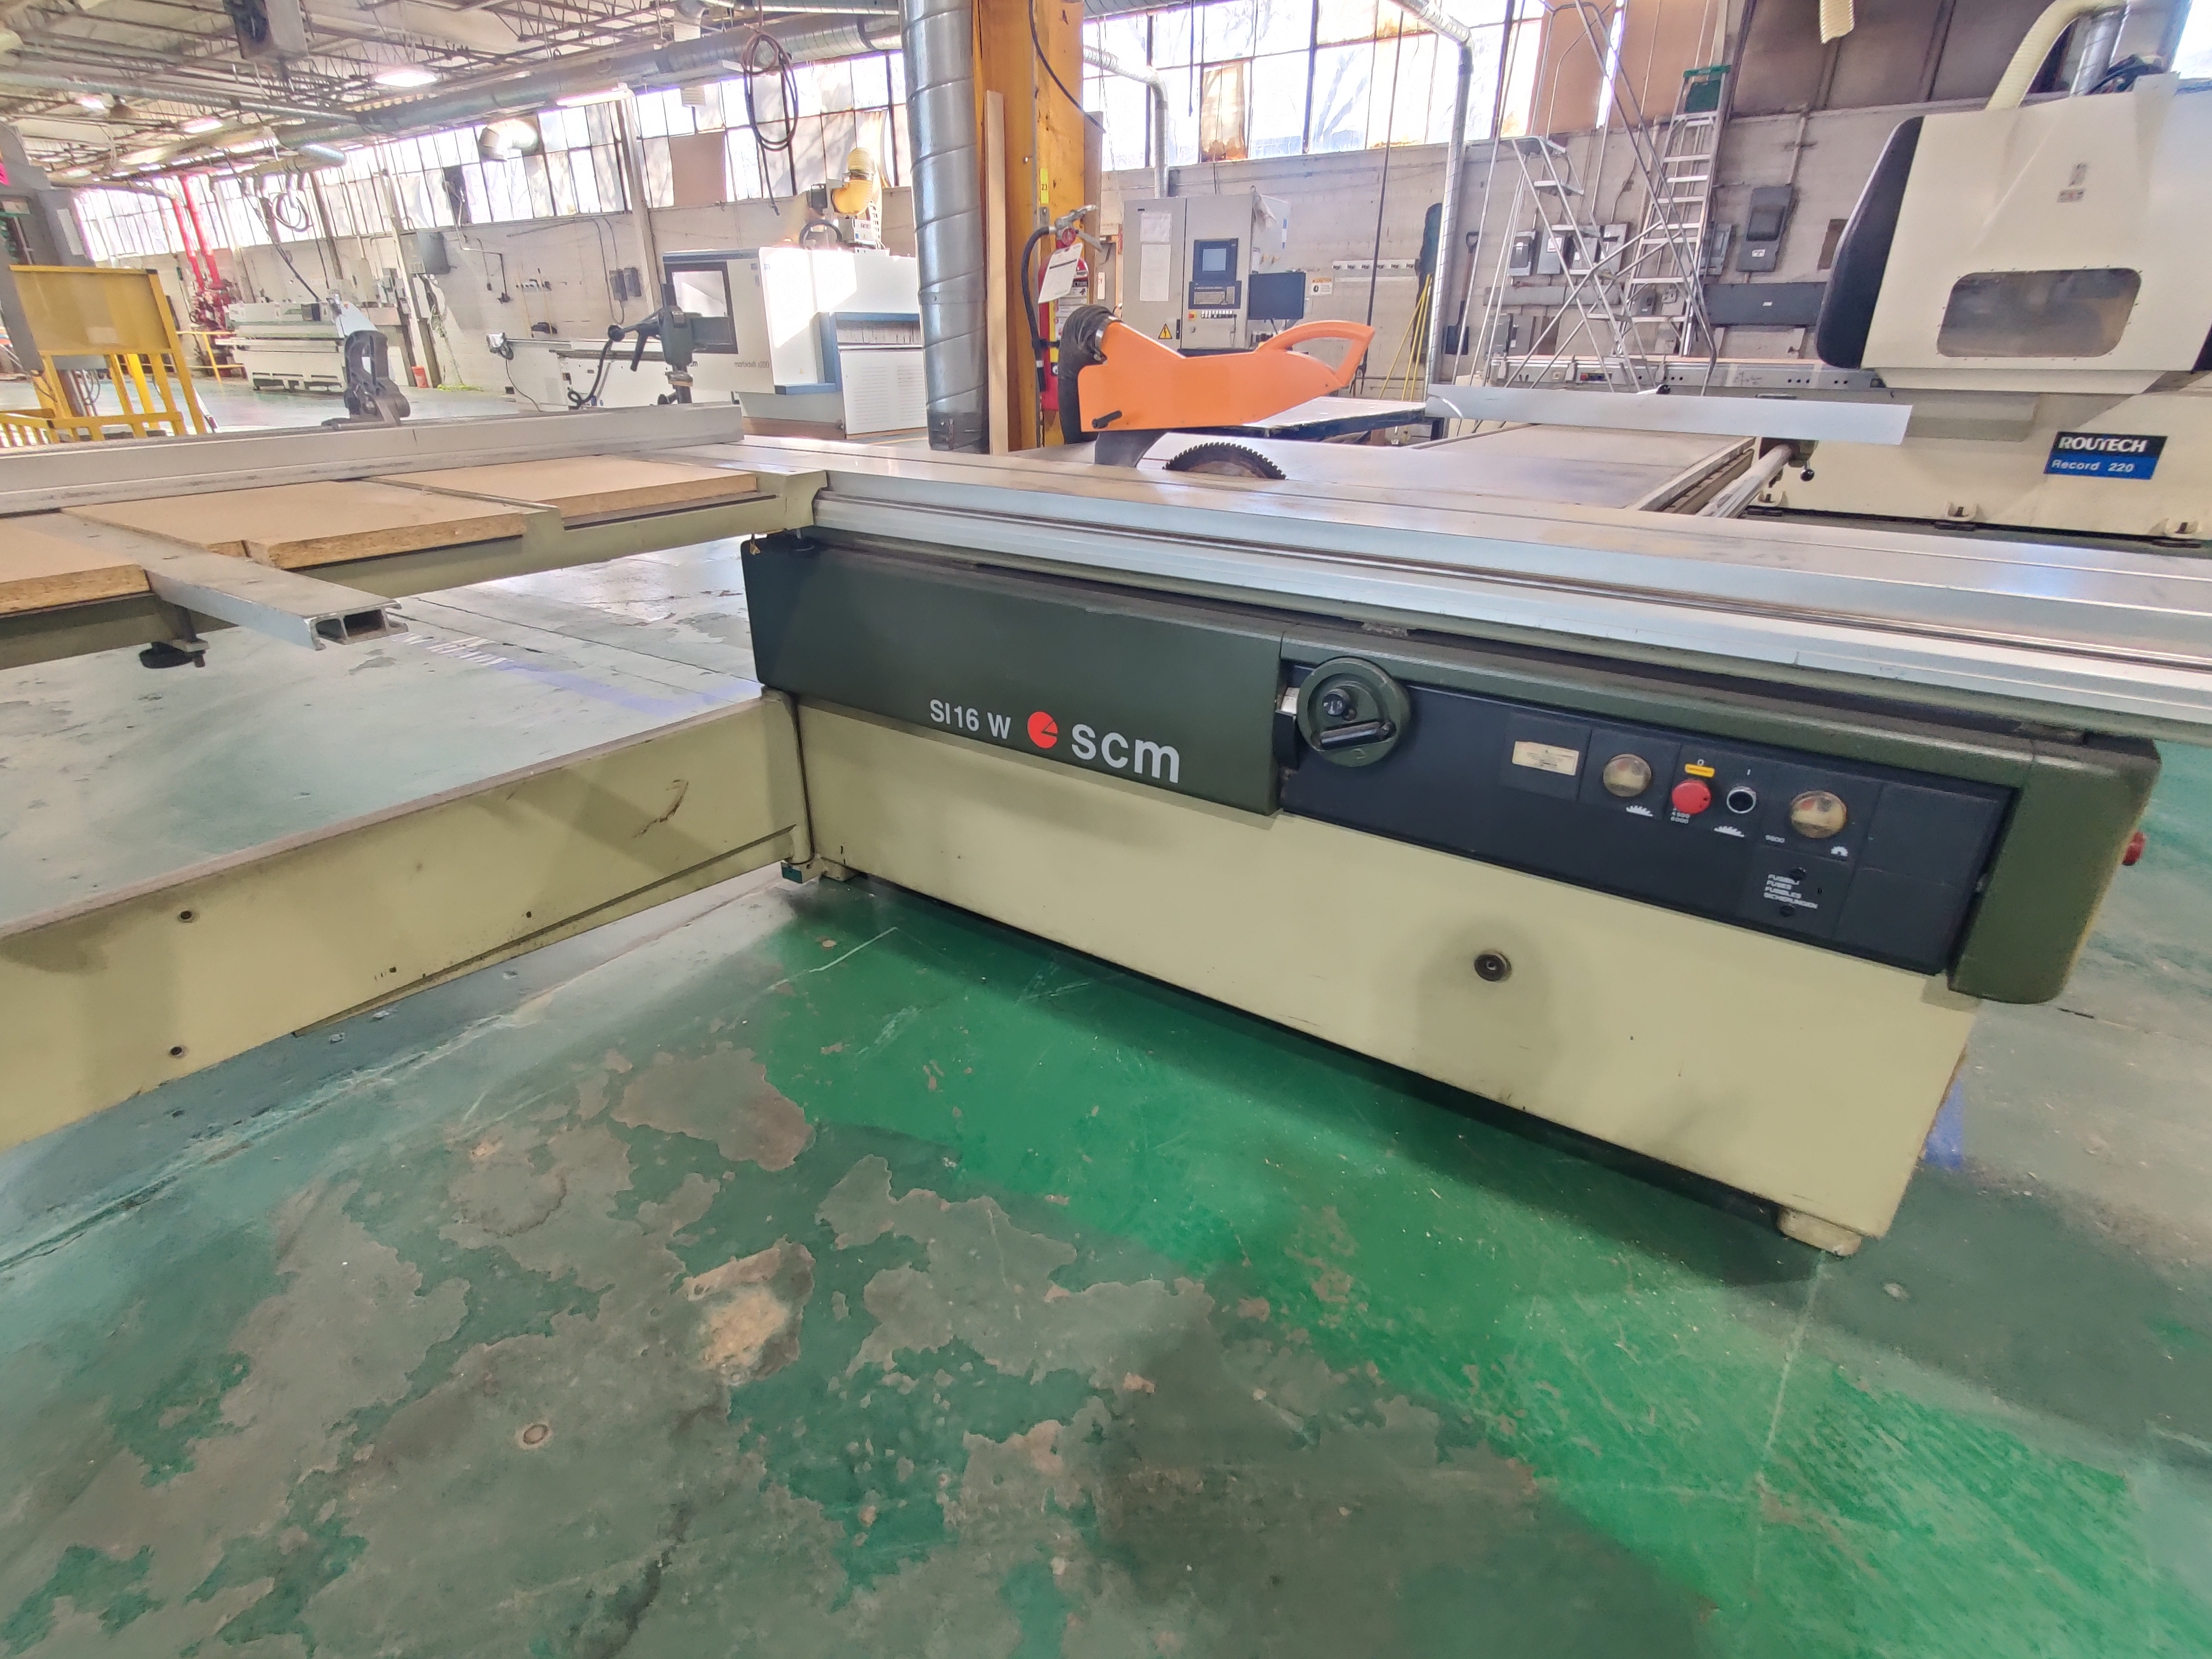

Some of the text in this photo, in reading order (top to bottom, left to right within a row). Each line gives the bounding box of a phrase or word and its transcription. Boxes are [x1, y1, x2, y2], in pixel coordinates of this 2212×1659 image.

[2058, 436, 2148, 453] ROUTECH
[2051, 459, 2136, 473] Record 220
[929, 699, 1180, 784] SI16 W scm
